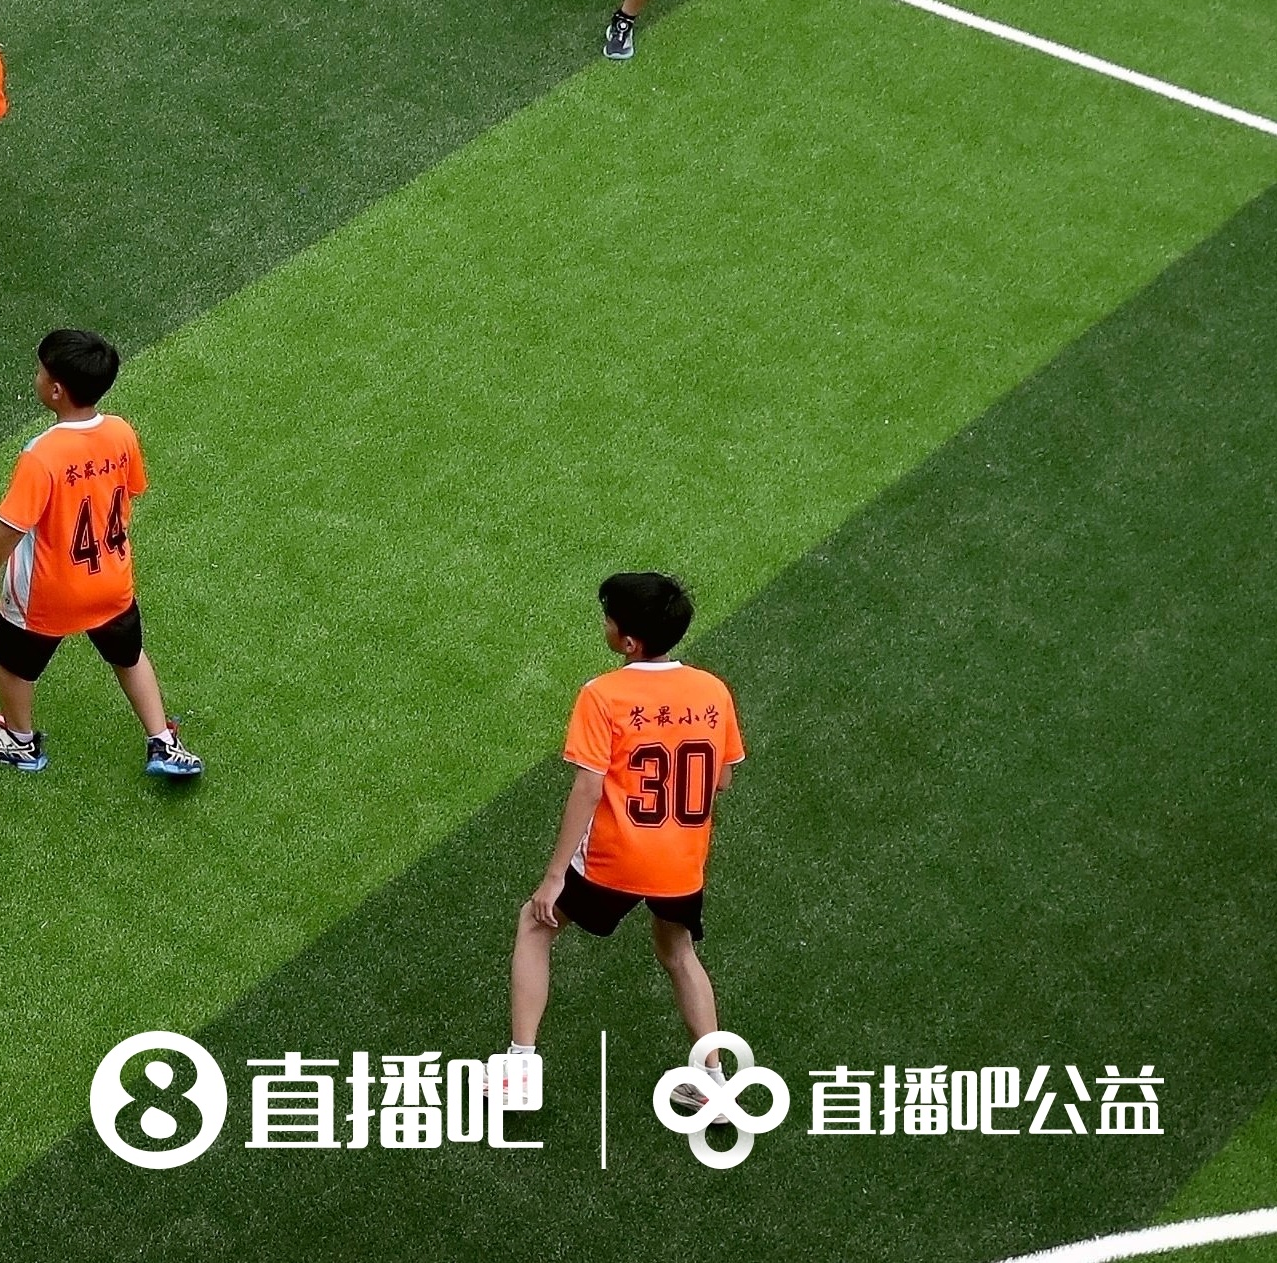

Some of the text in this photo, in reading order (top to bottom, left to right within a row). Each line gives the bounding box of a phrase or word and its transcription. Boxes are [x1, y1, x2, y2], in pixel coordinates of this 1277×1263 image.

[64, 452, 130, 487] 岑最小学
[69, 485, 129, 576] 44
[629, 704, 720, 731] 岑最小学
[625, 739, 717, 829] 30
